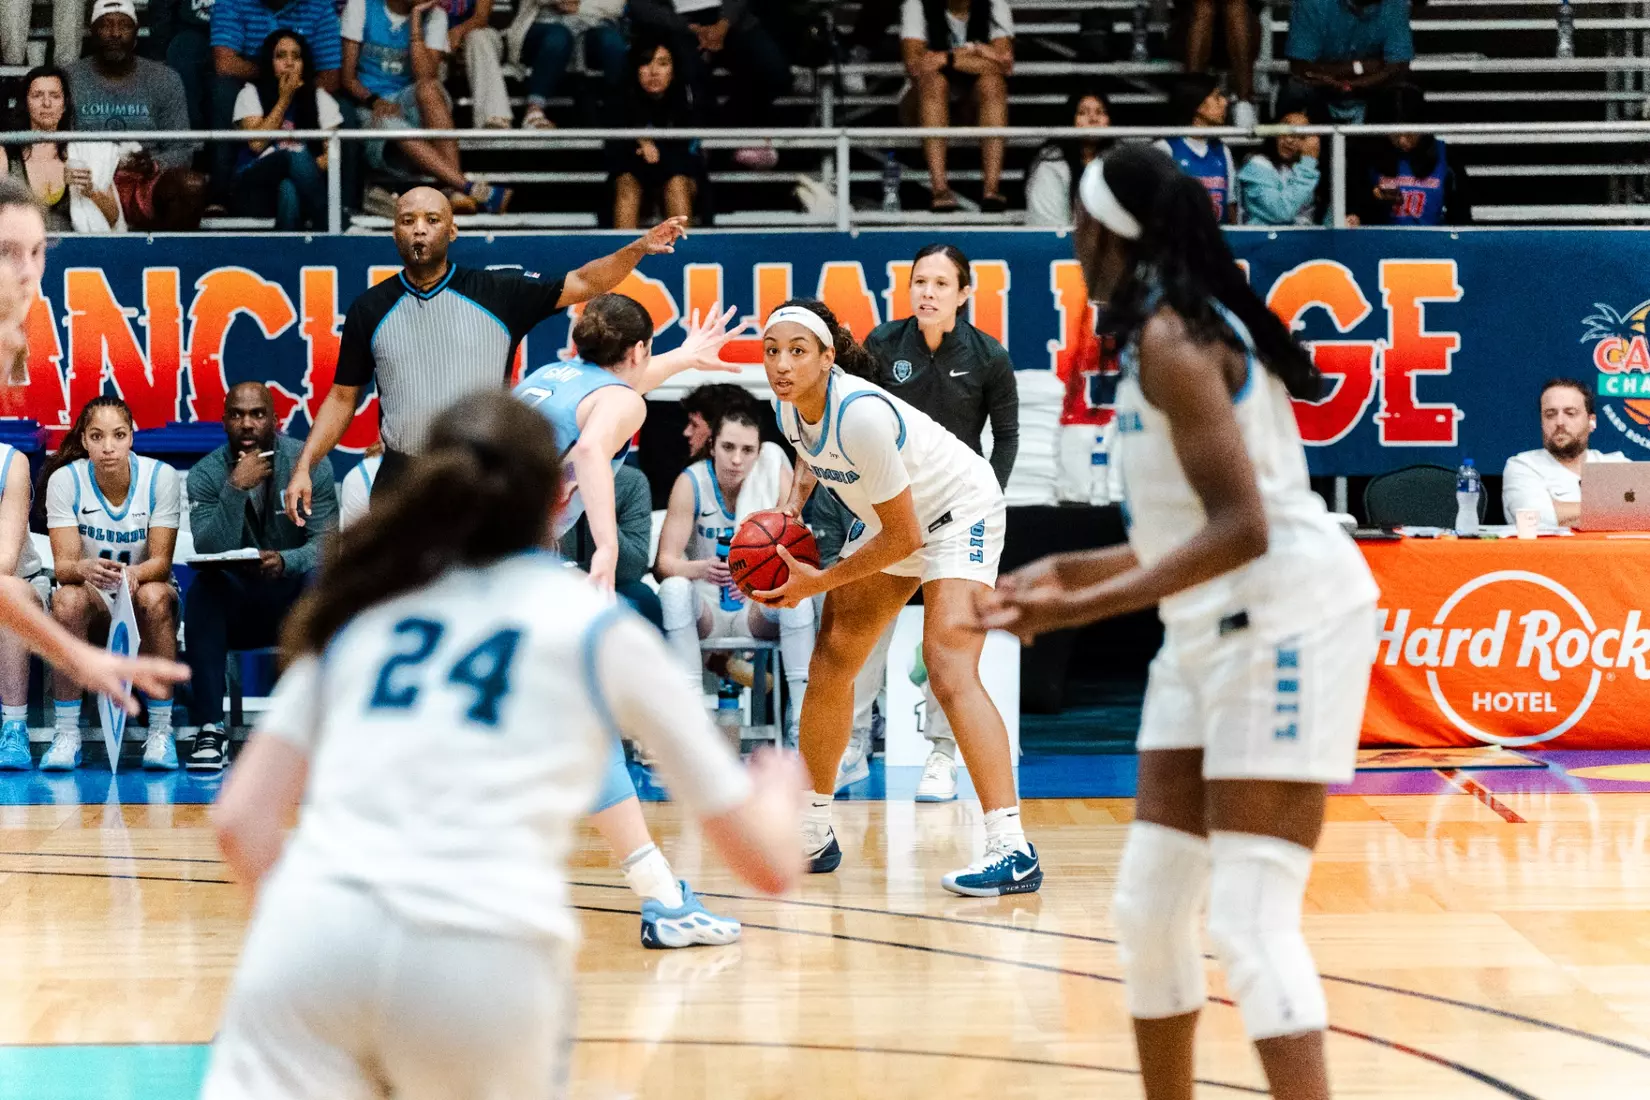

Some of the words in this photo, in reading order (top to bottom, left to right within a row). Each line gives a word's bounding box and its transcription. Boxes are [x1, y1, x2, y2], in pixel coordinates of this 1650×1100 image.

[81, 102, 150, 116] COLUMBIA
[969, 518, 986, 564] LIO
[1371, 608, 1512, 667] Hard
[1515, 609, 1650, 681] Rock
[369, 617, 522, 726] 24
[1472, 692, 1558, 713] HOTEL
